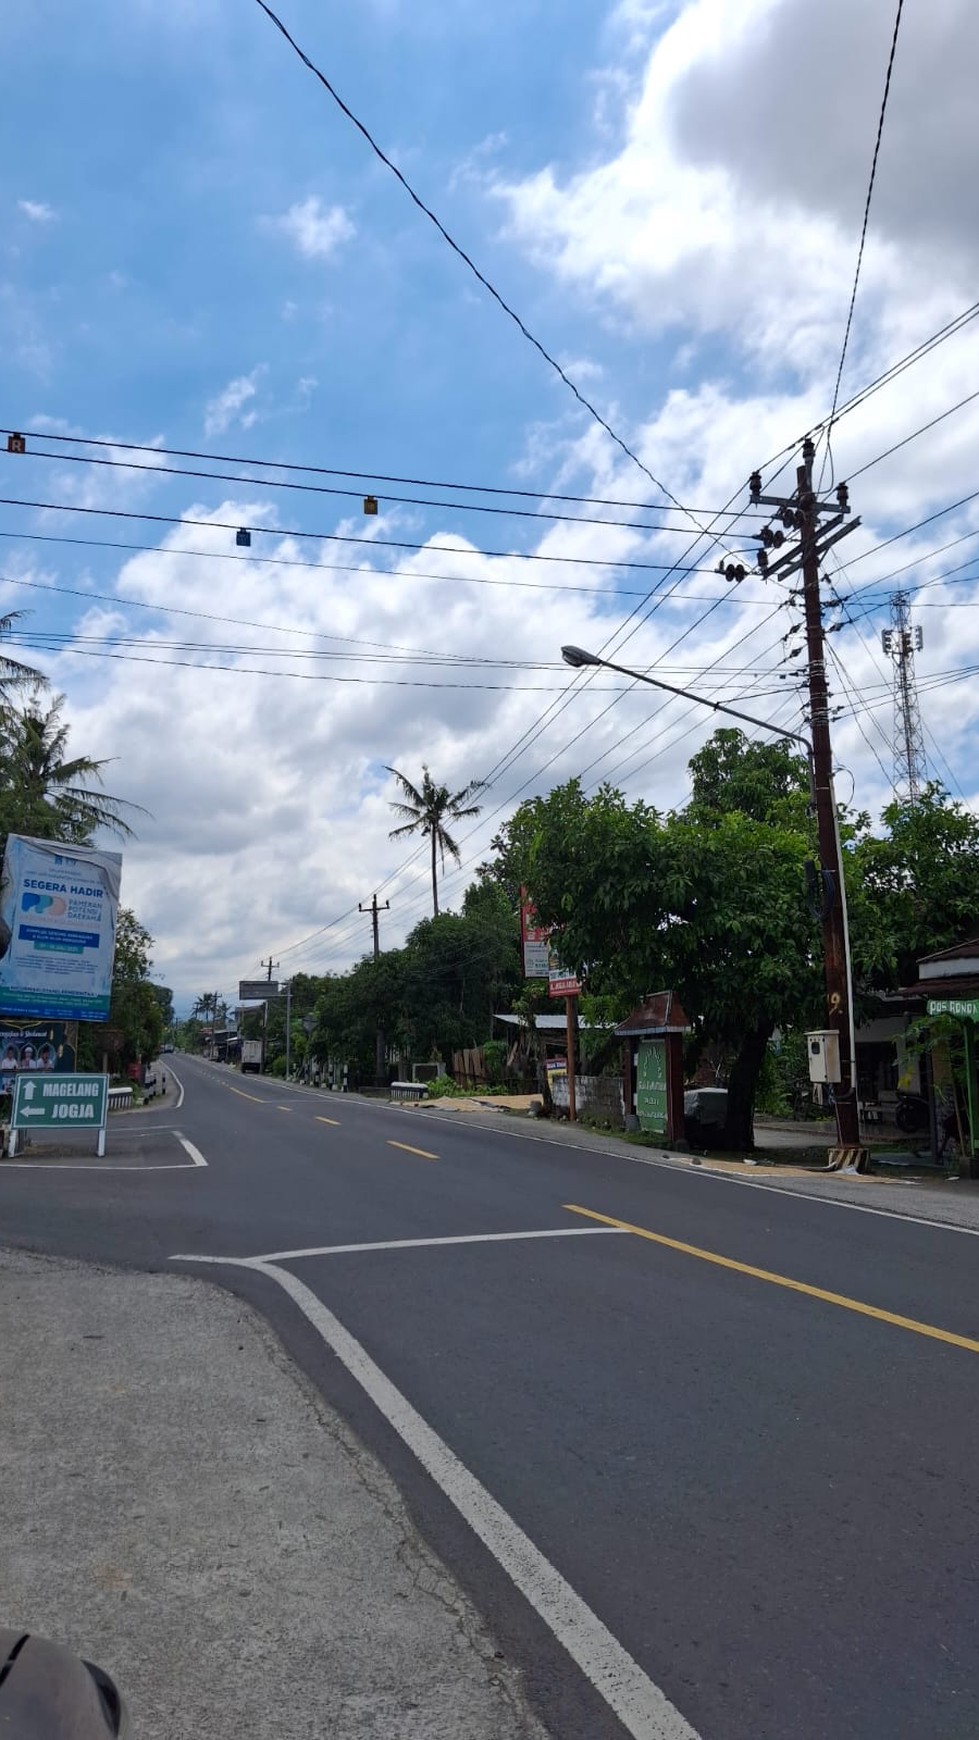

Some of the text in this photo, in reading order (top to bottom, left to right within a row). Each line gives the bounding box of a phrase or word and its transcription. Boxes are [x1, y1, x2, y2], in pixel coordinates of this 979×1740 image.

[12, 440, 22, 452] R
[23, 879, 104, 898] SEGERA HADIR
[68, 899, 102, 909] PAMERAN
[68, 905, 98, 914] POTENSI
[67, 912, 98, 921] DAERAH
[929, 1001, 947, 1015] POS
[43, 1083, 99, 1097] MAGELANG
[52, 1104, 95, 1119] JOGJA
